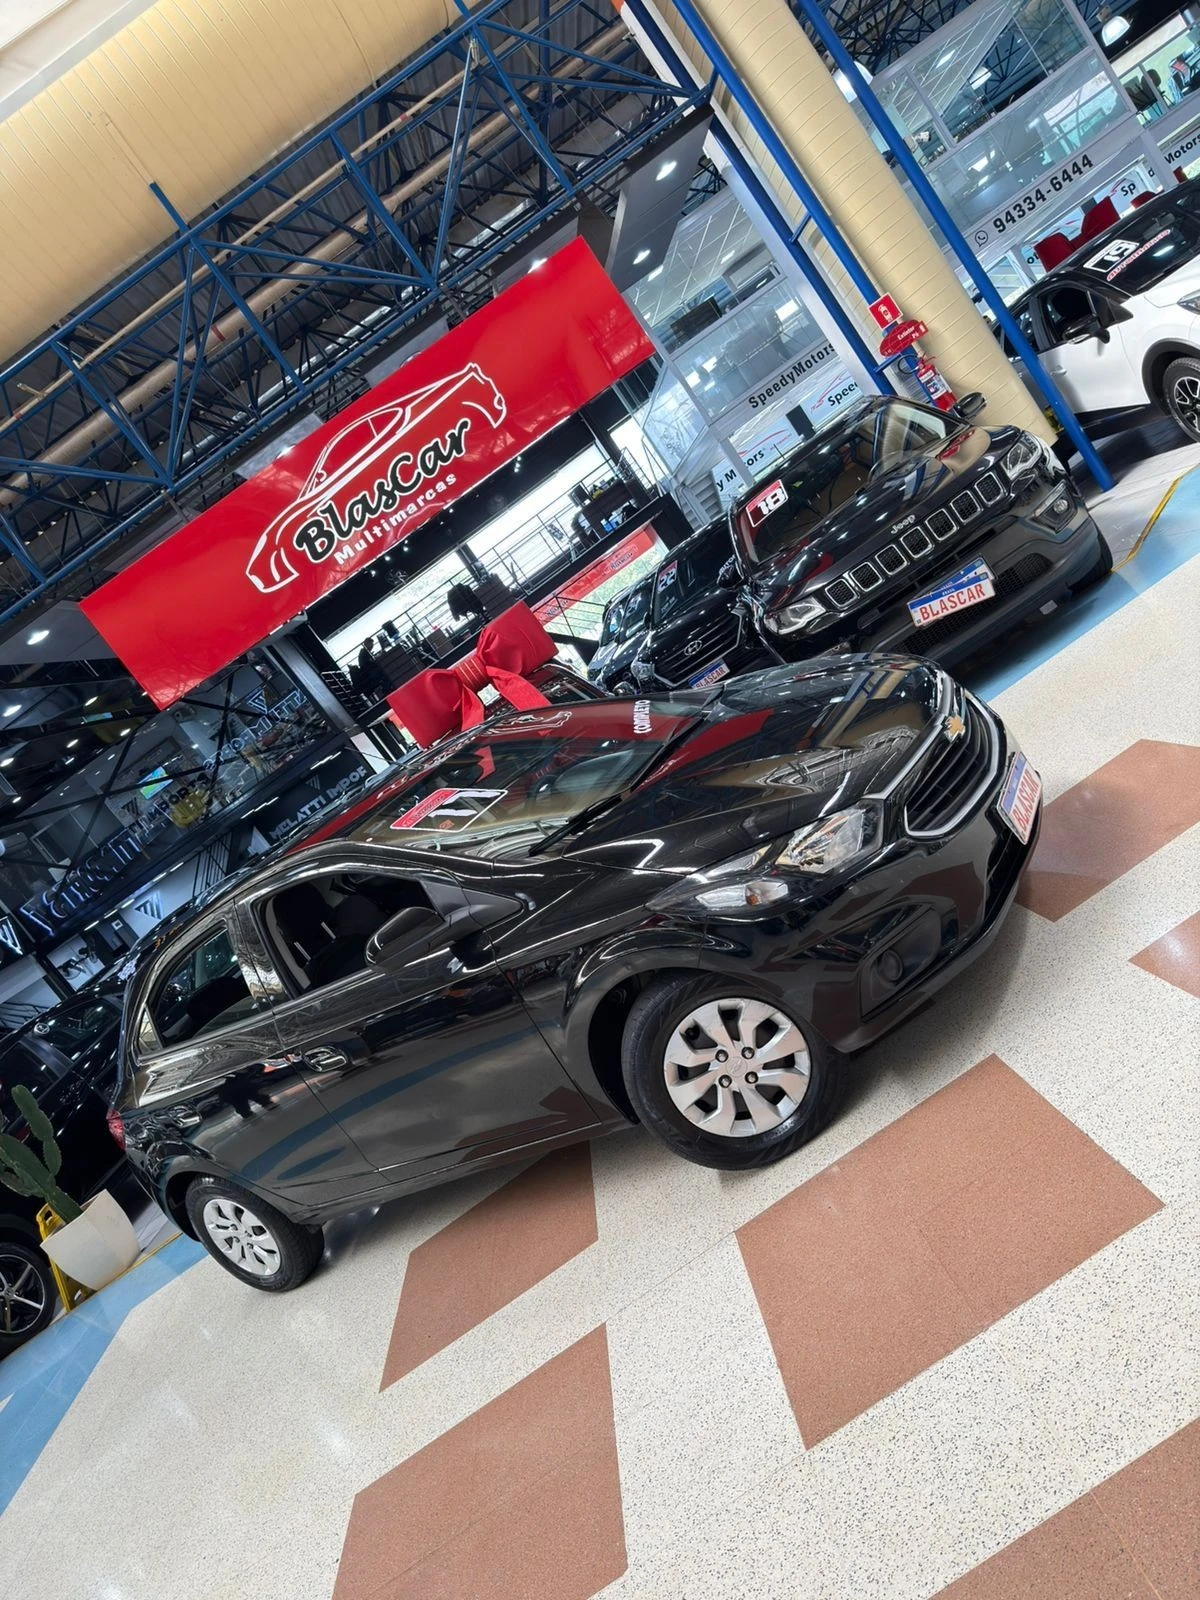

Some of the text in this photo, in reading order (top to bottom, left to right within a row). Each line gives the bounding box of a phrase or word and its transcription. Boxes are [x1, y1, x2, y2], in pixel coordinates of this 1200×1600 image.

[992, 154, 1094, 234] 94334-6444
[748, 343, 835, 408] SpeedyMotors
[293, 418, 471, 563] BlasCar
[756, 482, 786, 516] 18
[333, 473, 457, 565] Multimarcas
[890, 514, 915, 534] Jeep
[919, 585, 985, 621] BLASCAR
[633, 699, 652, 733] COMPLETO
[269, 795, 327, 840] MELATTI
[1012, 769, 1037, 829] BLASCAR
